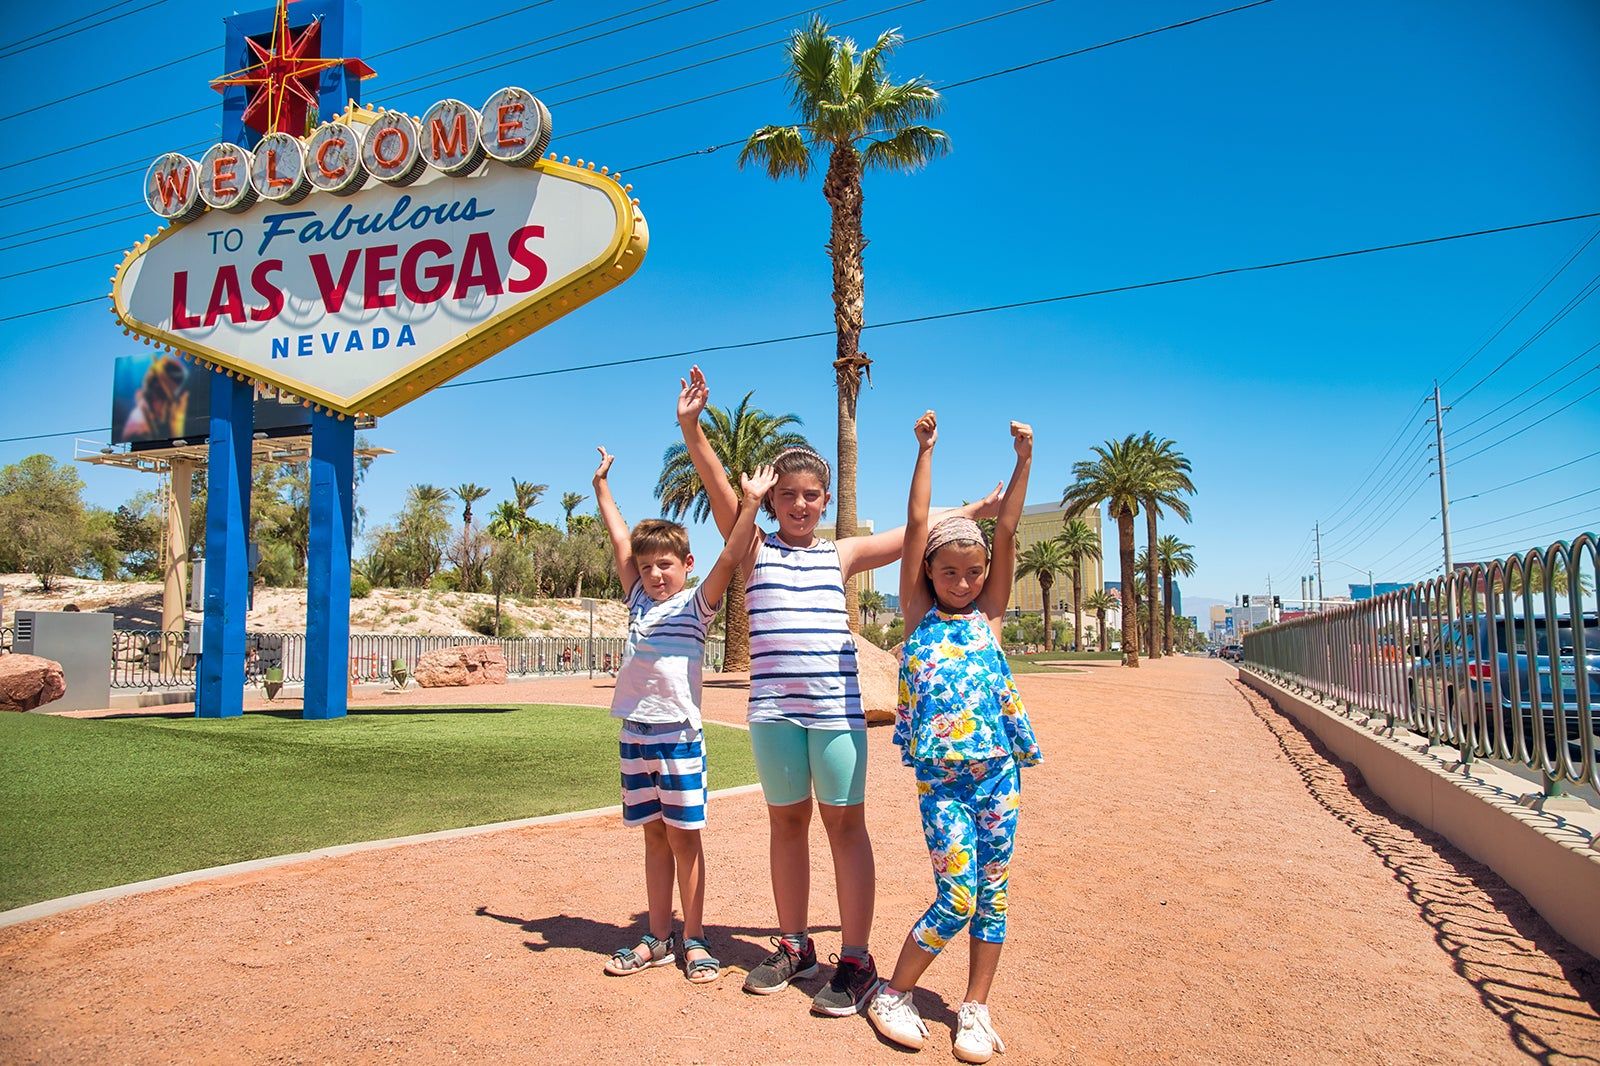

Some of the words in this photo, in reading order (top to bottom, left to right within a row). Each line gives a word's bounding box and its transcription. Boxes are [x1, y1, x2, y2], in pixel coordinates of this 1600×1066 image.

[154, 102, 526, 208] WELCOME
[207, 229, 244, 254] TO
[258, 194, 495, 256] Fabulous
[171, 259, 285, 330] LAS
[309, 225, 549, 314] VEGAS
[271, 325, 416, 359] NEVADA
